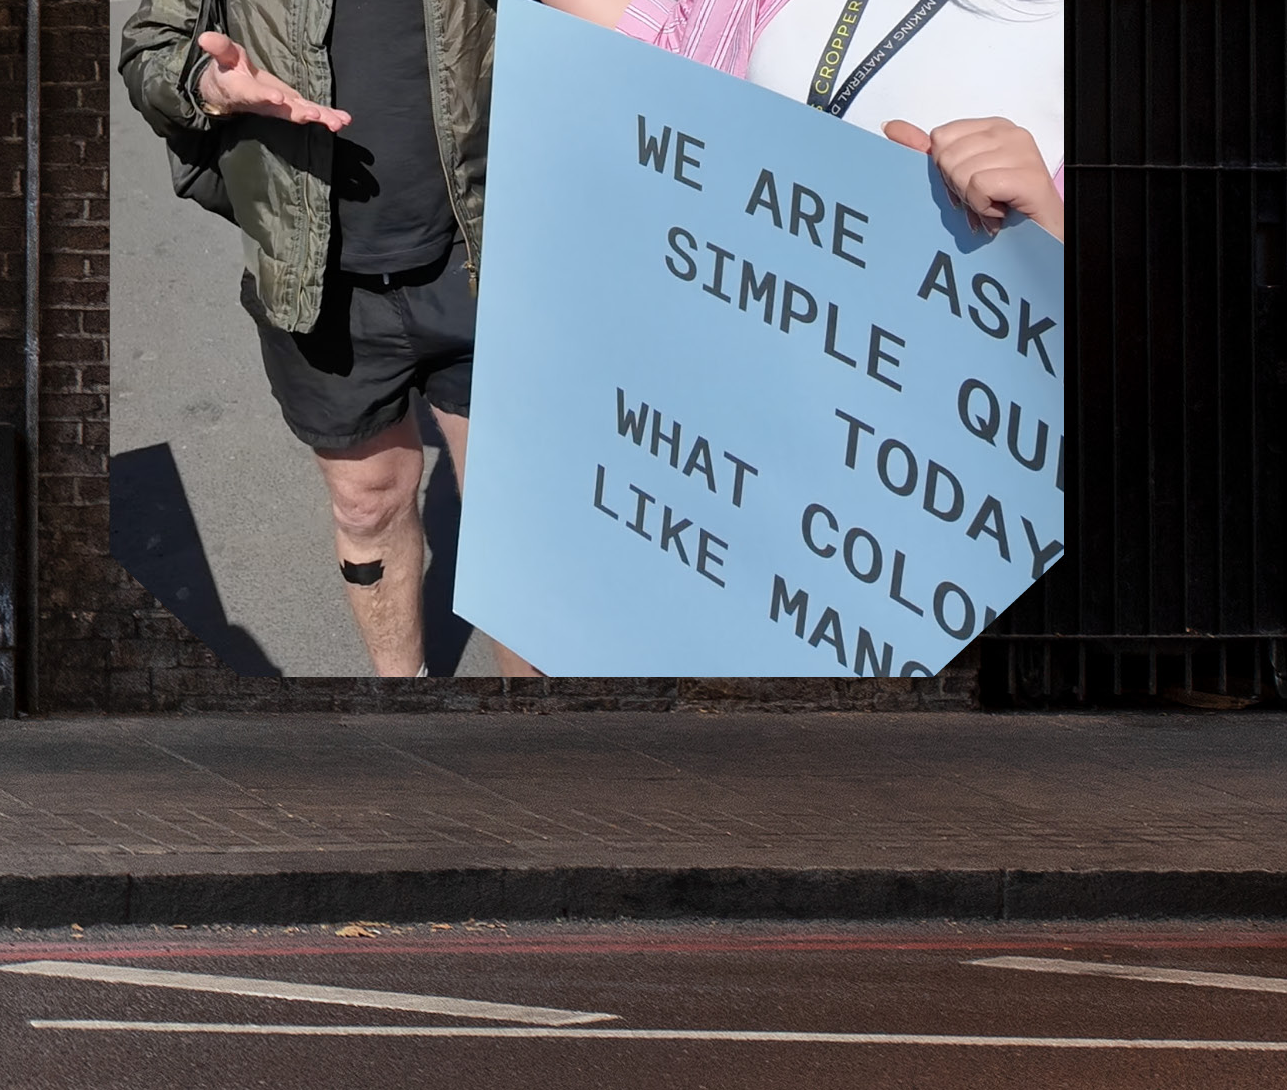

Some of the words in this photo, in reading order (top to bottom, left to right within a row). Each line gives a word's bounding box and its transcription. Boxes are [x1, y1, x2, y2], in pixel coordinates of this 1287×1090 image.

[815, 0, 863, 95] CROPPER
[837, 50, 886, 102] MATERIAL
[881, 39, 894, 50] A
[638, 114, 706, 191] WE
[745, 168, 869, 270] ARE
[665, 226, 906, 392] SIMPLE
[957, 378, 1064, 493] QU
[594, 464, 729, 588] LIKE
[616, 387, 759, 508] WHAT
[801, 503, 997, 641] COLO
